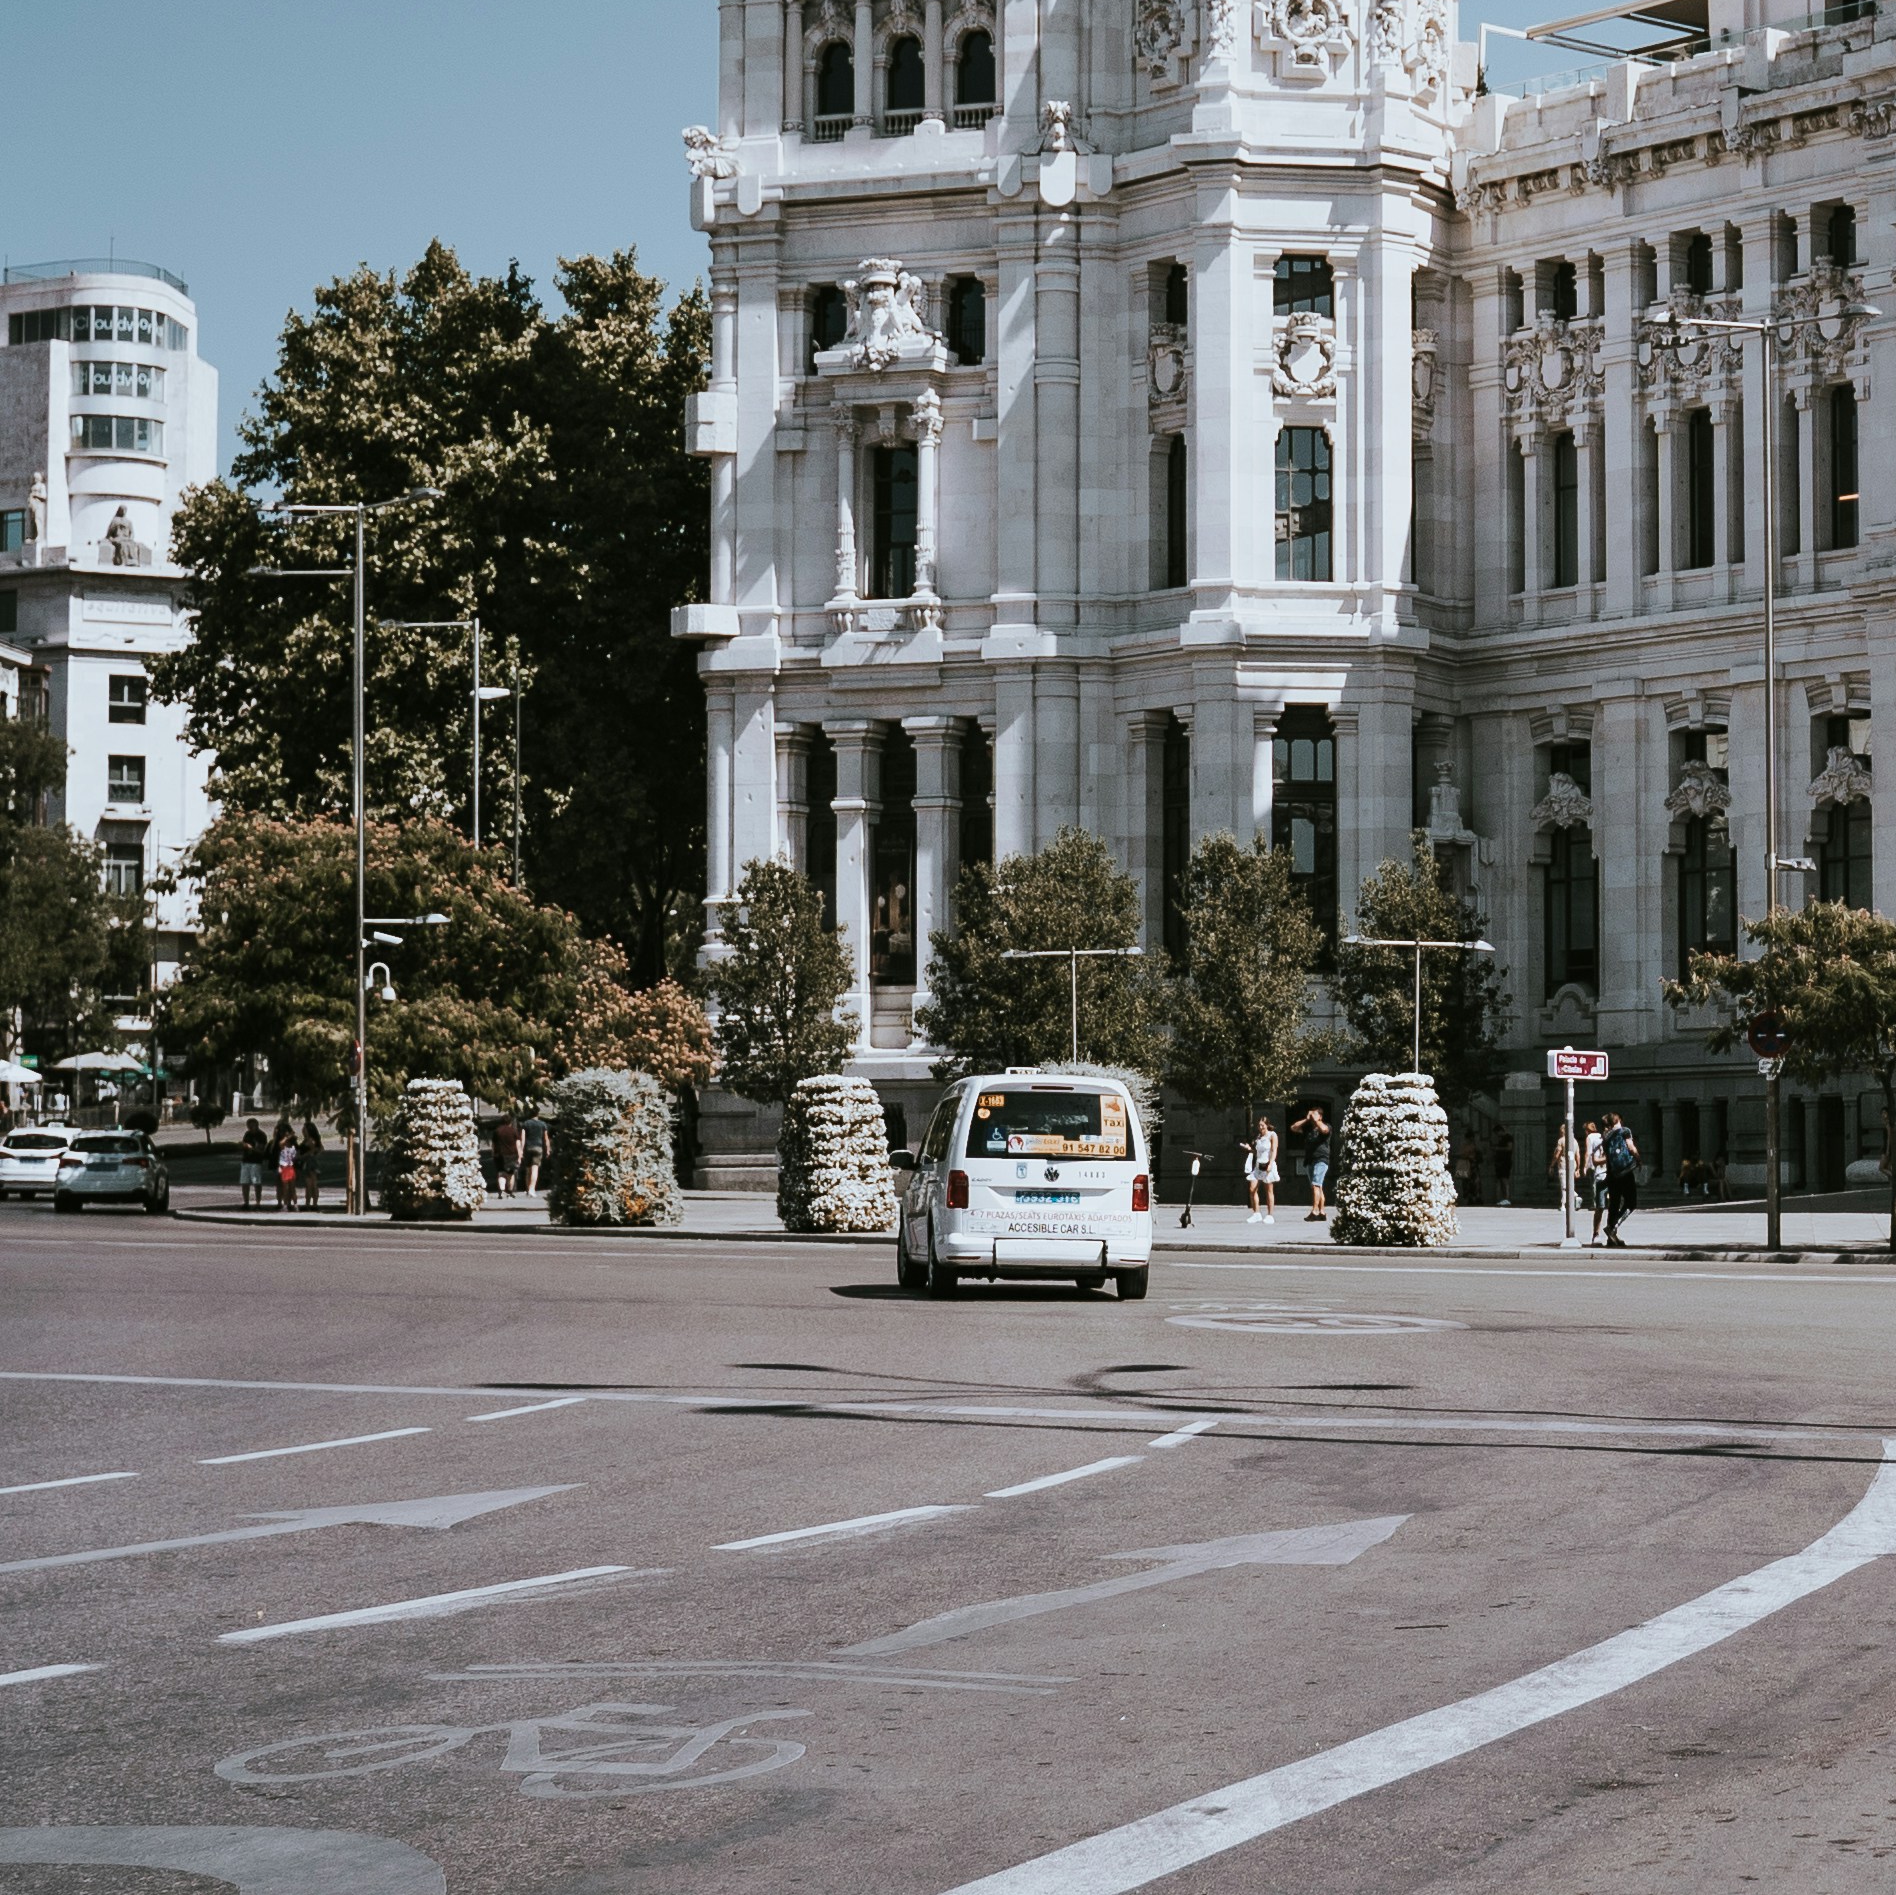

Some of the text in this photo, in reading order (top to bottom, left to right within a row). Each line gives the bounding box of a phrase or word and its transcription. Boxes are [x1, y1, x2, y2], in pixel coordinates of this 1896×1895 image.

[1077, 1143, 1096, 1153] 547
[1087, 1213, 1133, 1224] ADAPTADOS
[1008, 1222, 1058, 1234] ACCESIBLE
[1060, 1223, 1079, 1235] CAR
